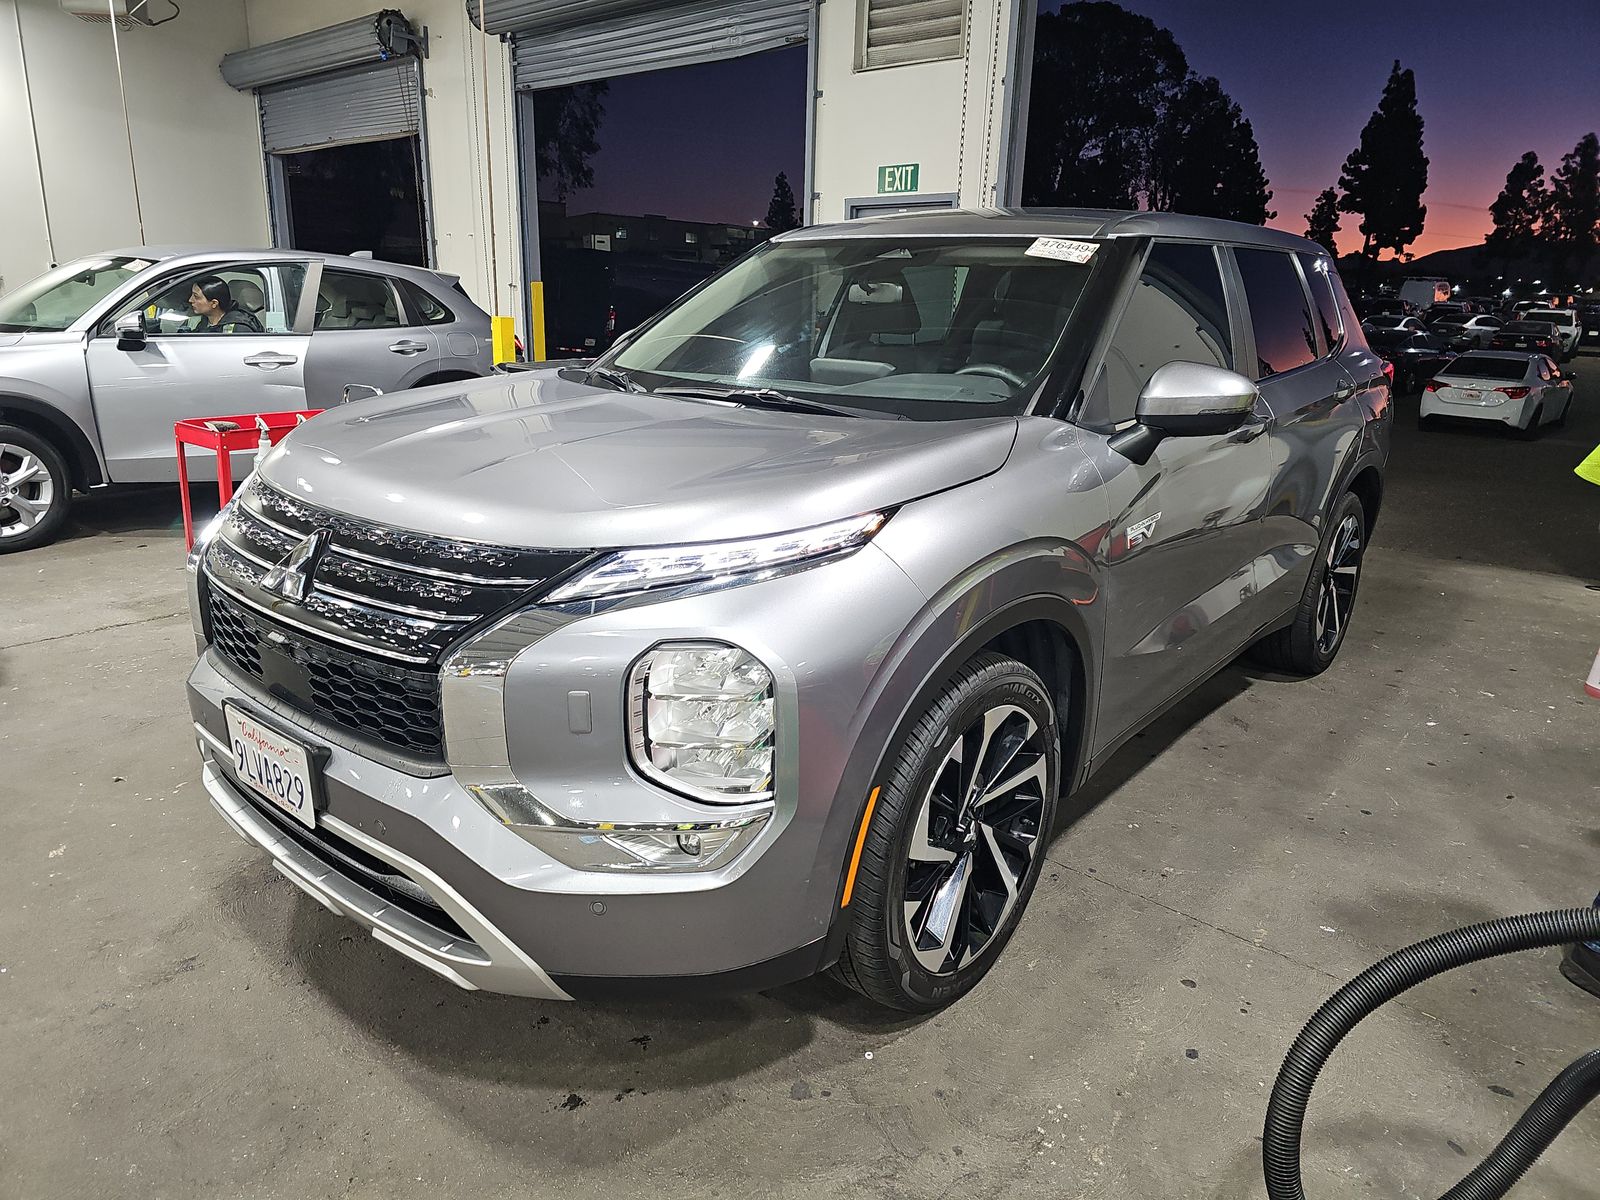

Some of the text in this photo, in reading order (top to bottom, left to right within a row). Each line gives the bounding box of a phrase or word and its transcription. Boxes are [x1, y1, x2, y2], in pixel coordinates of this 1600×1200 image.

[885, 166, 914, 191] EXIT
[241, 721, 291, 763] California
[235, 739, 304, 809] 9LVA829
